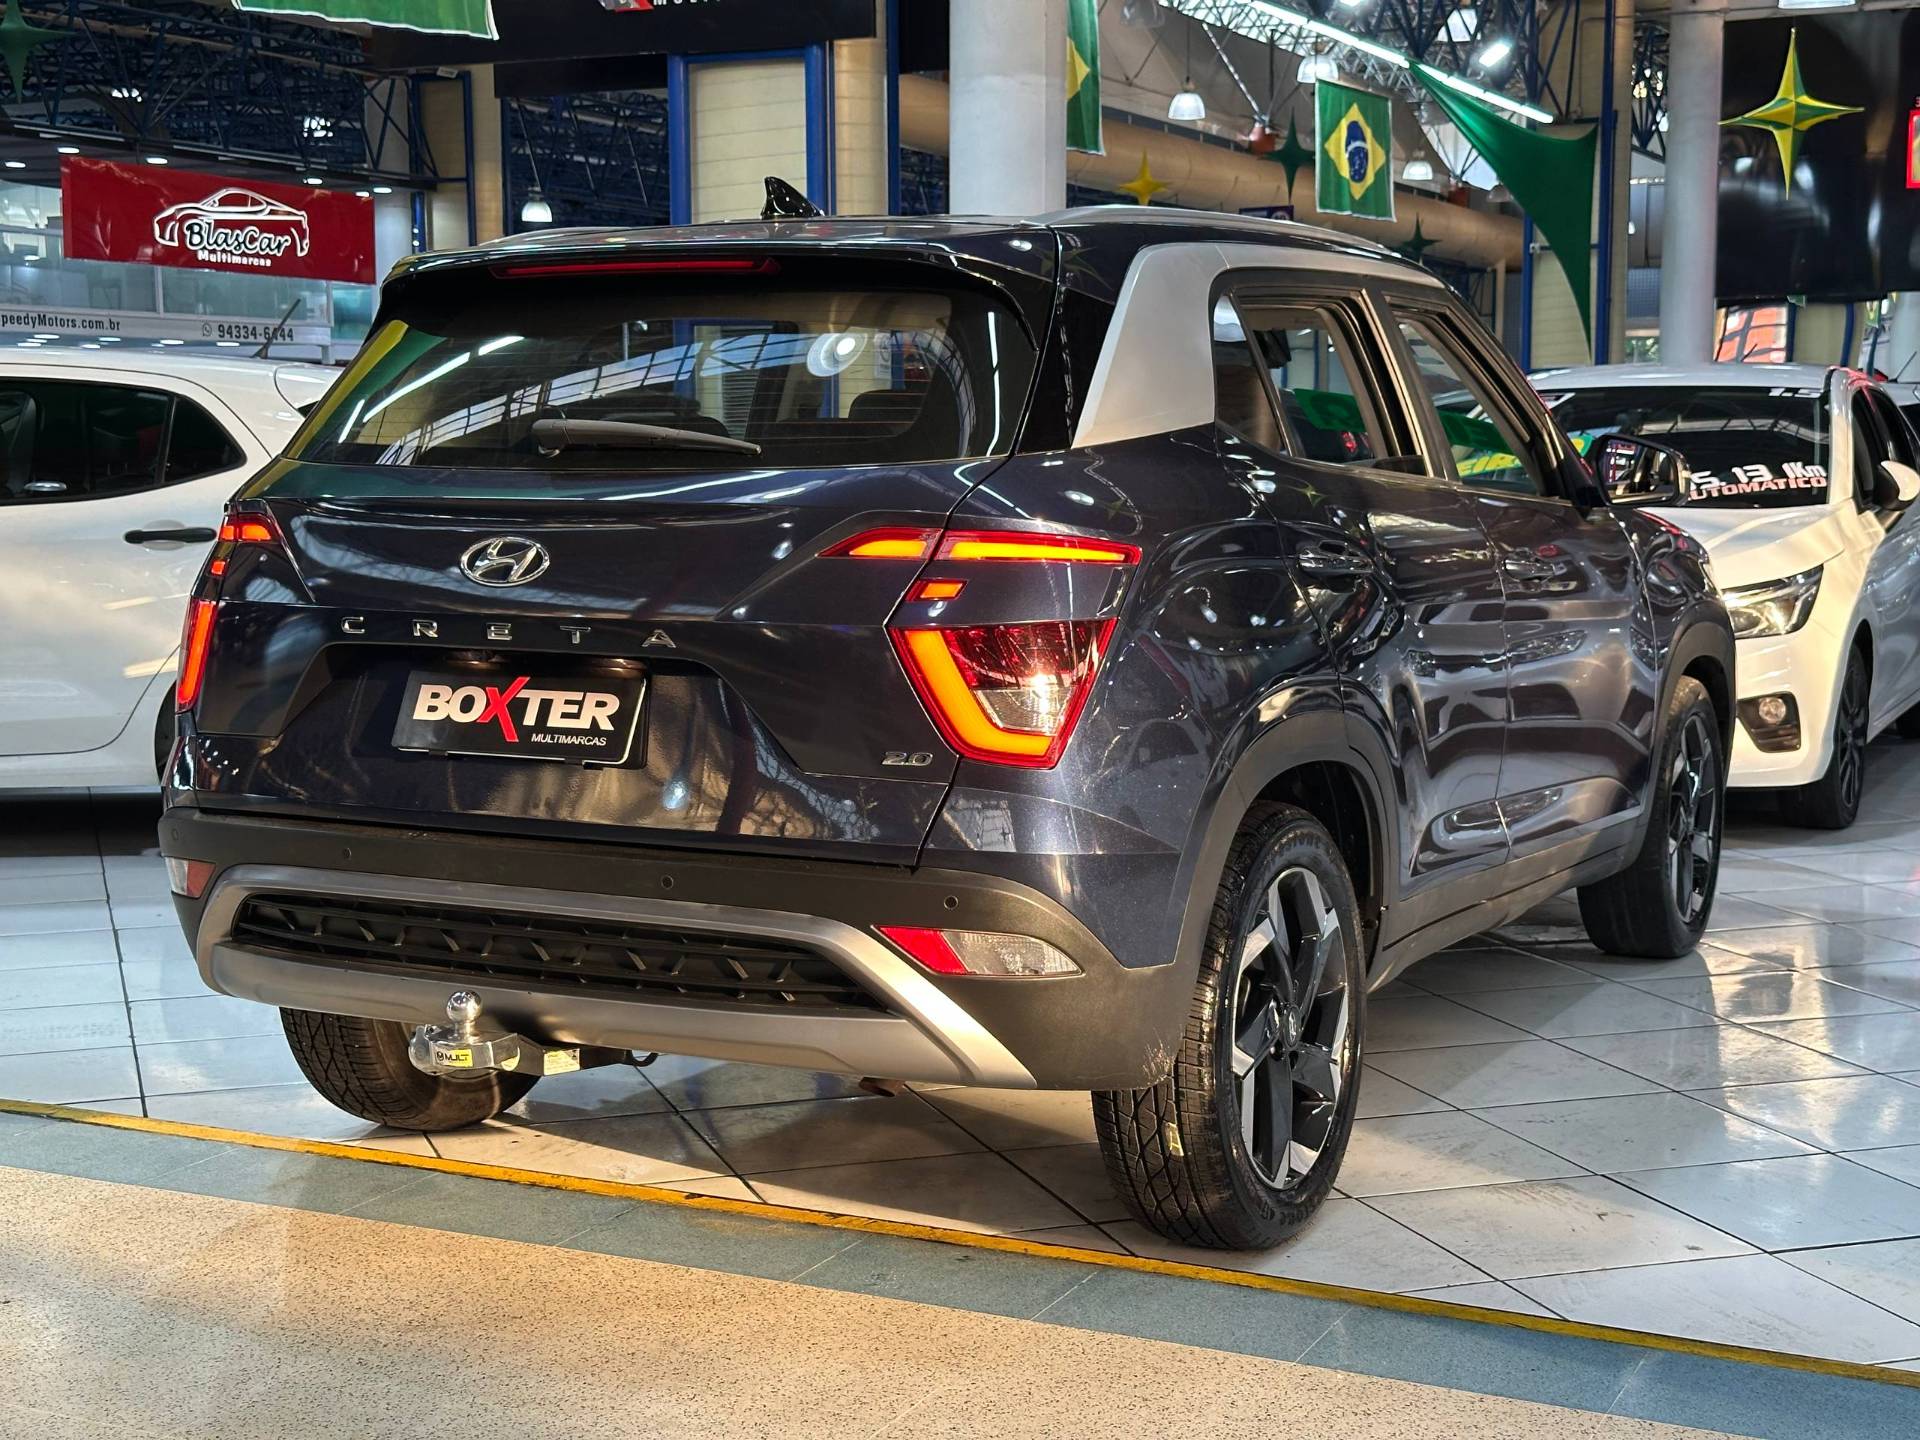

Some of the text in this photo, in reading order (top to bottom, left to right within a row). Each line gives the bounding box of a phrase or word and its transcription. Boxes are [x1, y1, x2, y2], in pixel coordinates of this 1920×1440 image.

[184, 218, 291, 257] BlasCar
[197, 250, 272, 267] Multimarcas
[341, 616, 676, 648] CRETA
[412, 676, 620, 742] BOXTER
[531, 733, 607, 746] MULTIMARCAS
[882, 751, 933, 766] 2.0
